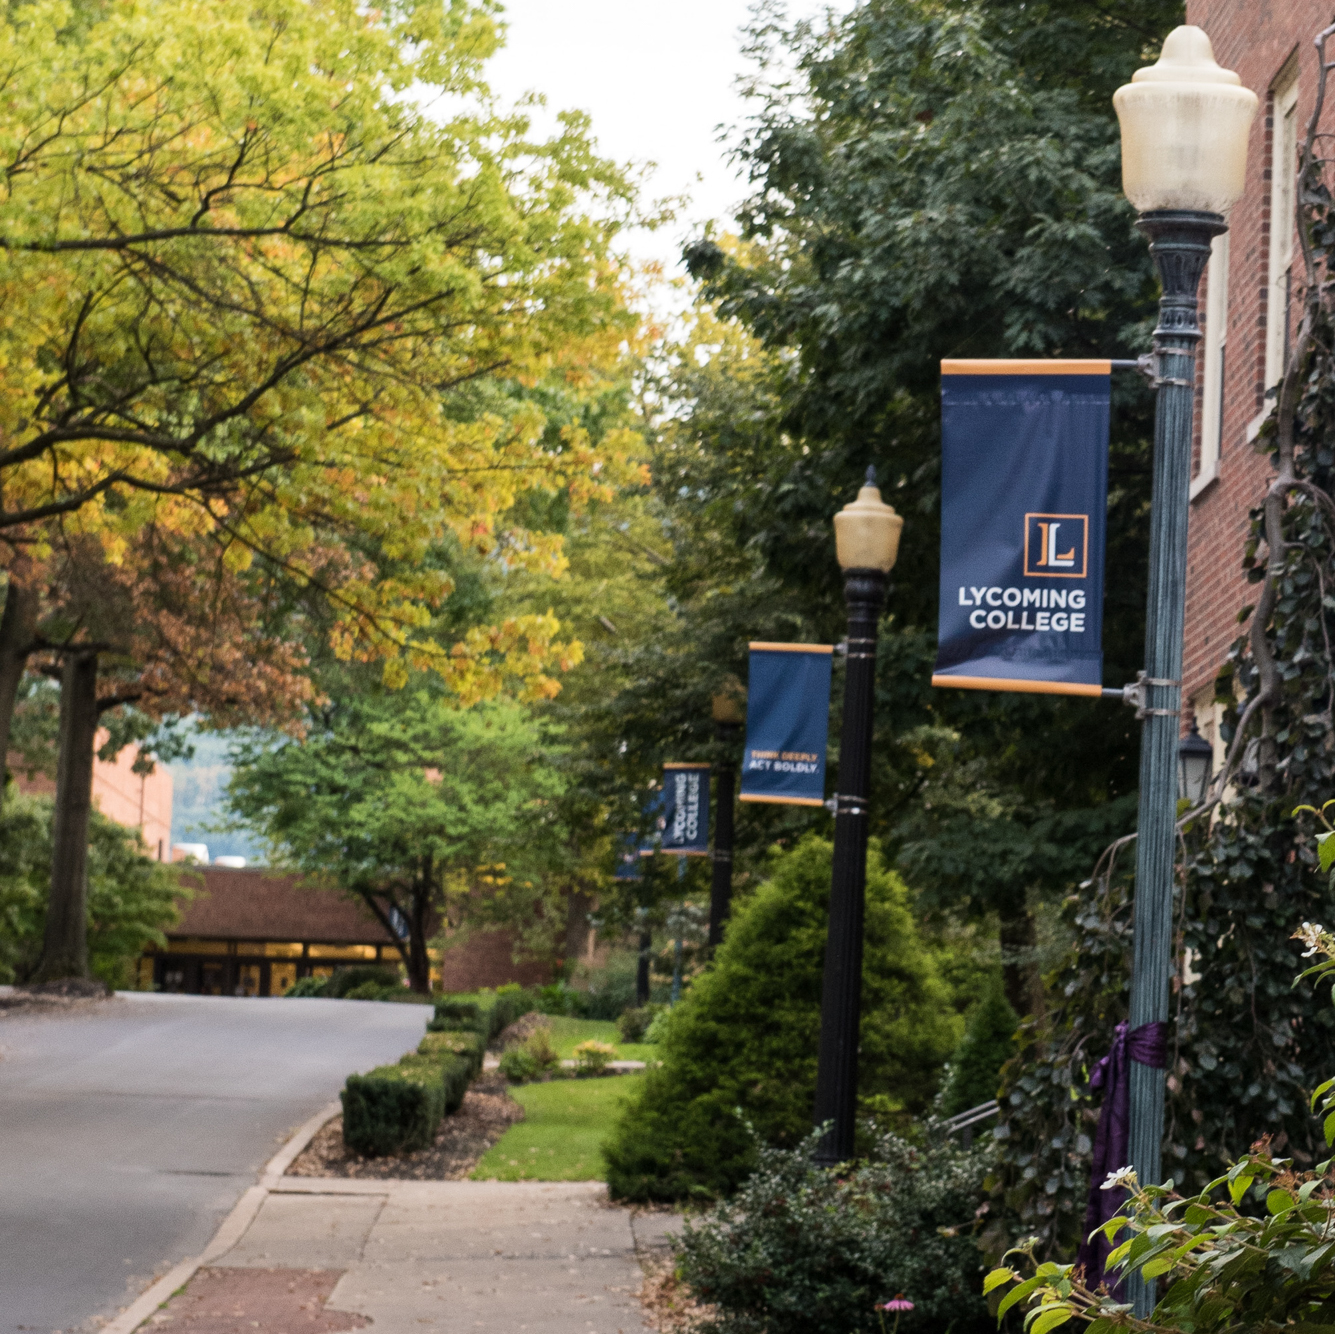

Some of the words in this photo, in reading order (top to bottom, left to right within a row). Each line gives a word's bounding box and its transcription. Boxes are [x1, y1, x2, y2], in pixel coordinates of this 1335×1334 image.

[958, 586, 1086, 609] LYCOMING
[969, 609, 1086, 633] COLLEGE
[749, 760, 771, 771] ACT
[686, 773, 699, 840] COLLEGE
